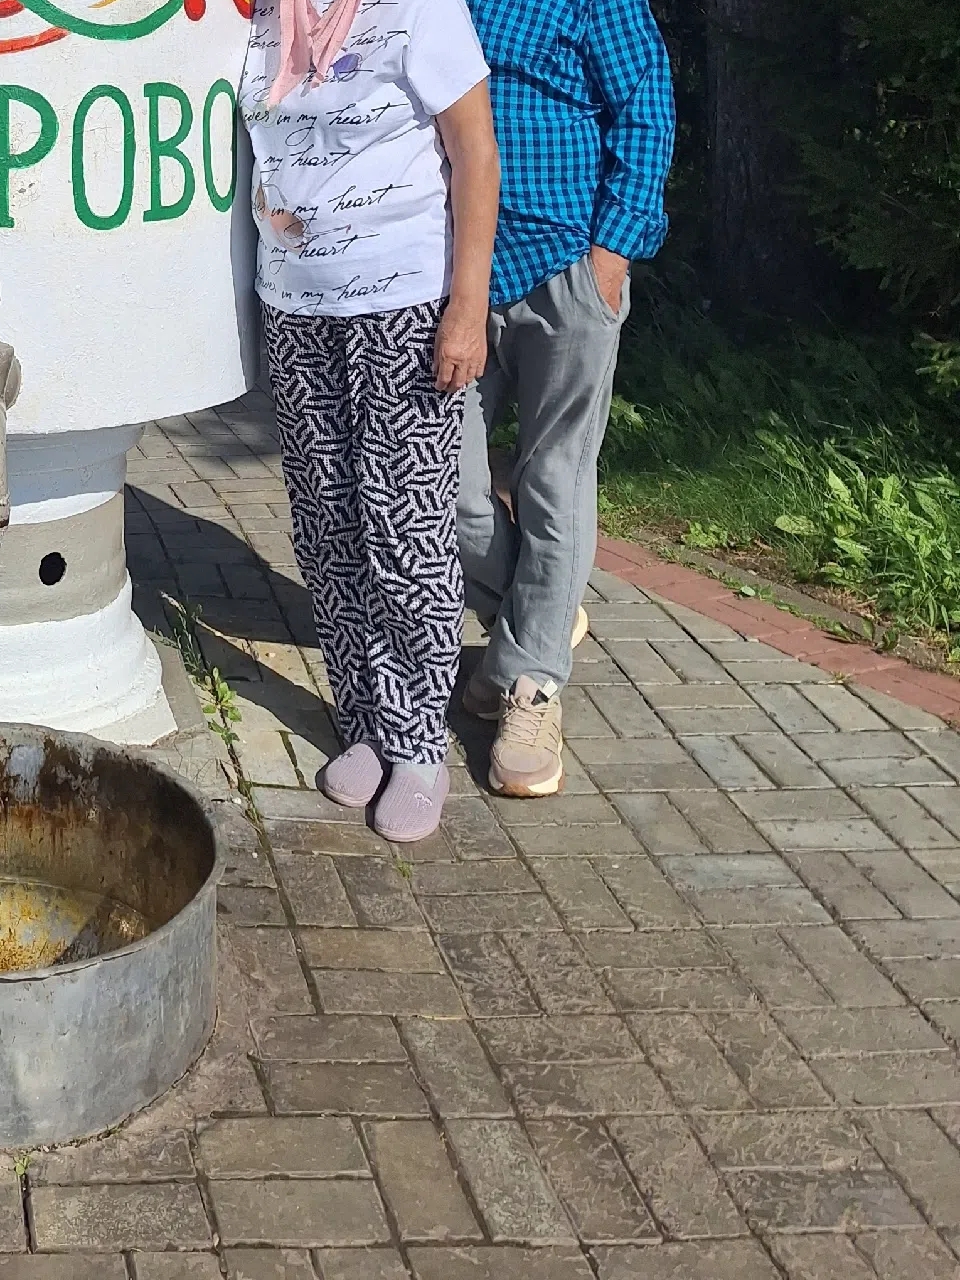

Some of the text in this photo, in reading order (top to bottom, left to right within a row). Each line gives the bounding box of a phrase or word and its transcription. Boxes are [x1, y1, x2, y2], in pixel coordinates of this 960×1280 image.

[350, 25, 408, 49] heart
[276, 111, 291, 125] in
[285, 114, 318, 147] my
[326, 102, 409, 126] heart
[260, 144, 357, 184] my heart
[271, 183, 413, 240] in my heart
[294, 234, 381, 260] heart
[292, 291, 324, 316] my
[332, 270, 423, 301] heart
